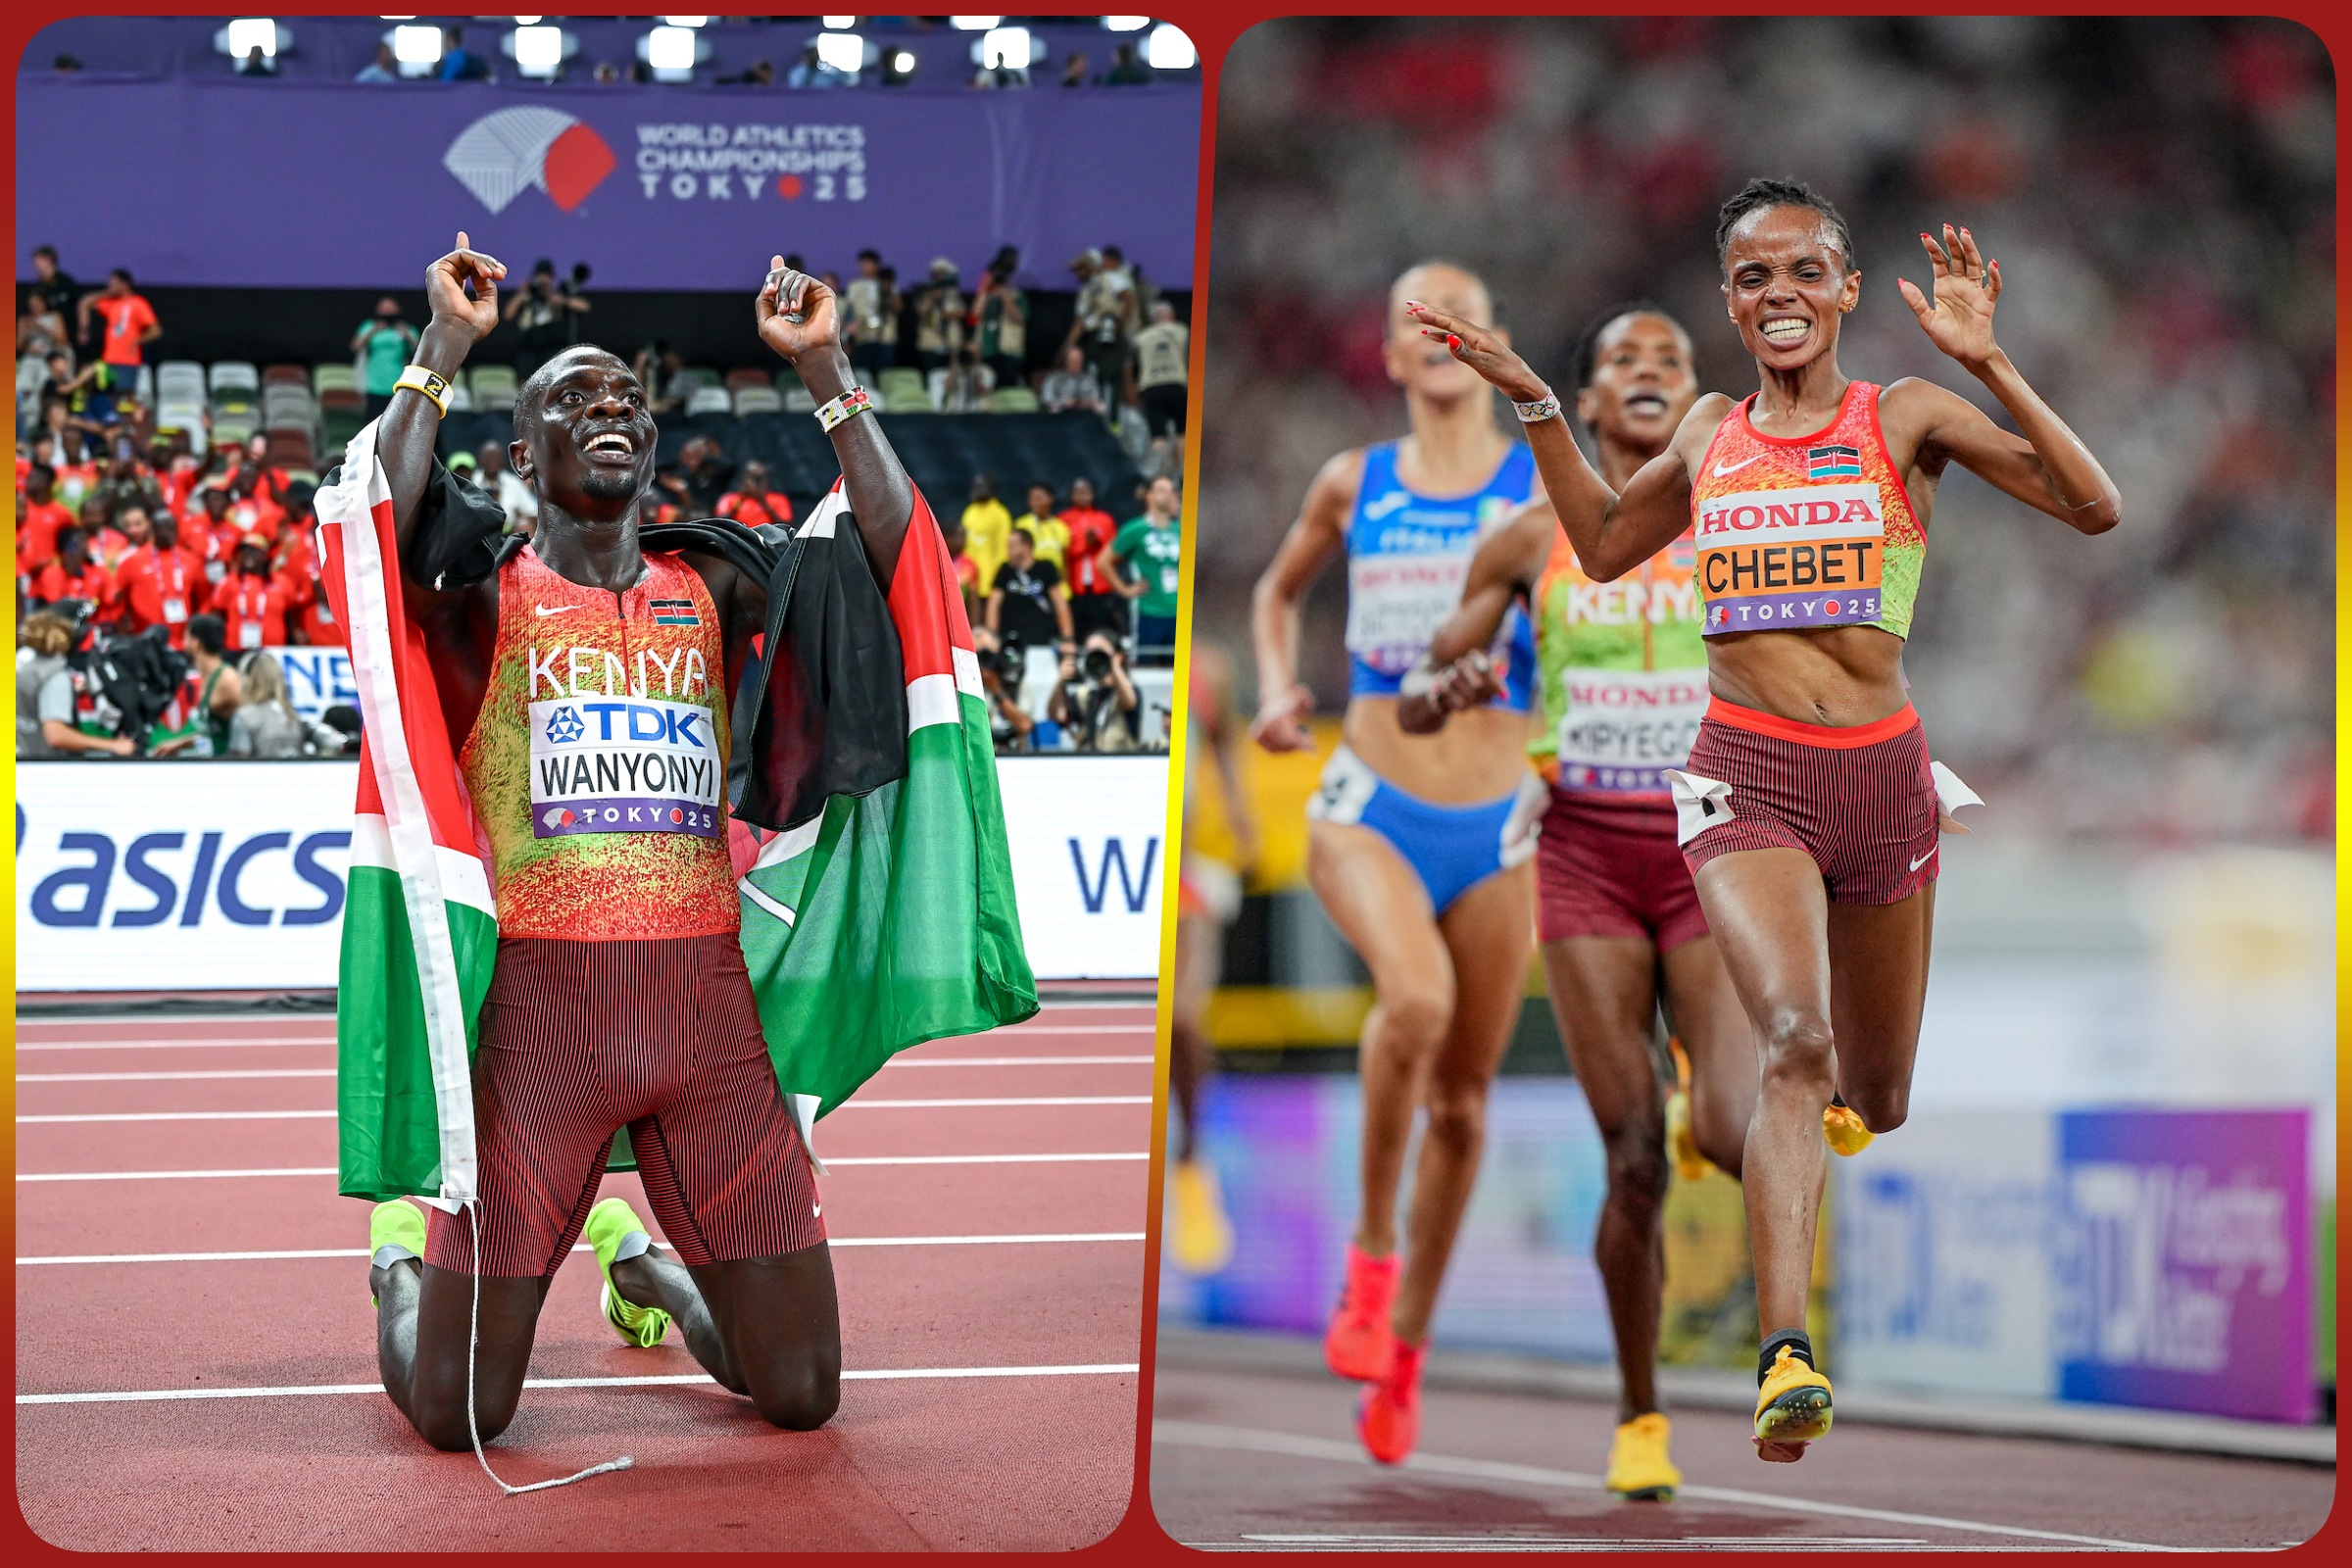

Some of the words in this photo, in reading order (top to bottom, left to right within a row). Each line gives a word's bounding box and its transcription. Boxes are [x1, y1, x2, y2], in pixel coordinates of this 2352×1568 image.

[637, 125, 729, 146] WORLD
[732, 125, 864, 146] ATHLETICS
[637, 149, 865, 172] CHAMPIONSHIPS
[814, 174, 865, 200] 25
[1699, 499, 1880, 536] HONDA
[1705, 542, 1873, 593] CHEBET
[1567, 580, 1699, 625] KENY
[1847, 598, 1876, 616] 25
[528, 646, 710, 700] KENYA
[1570, 681, 1709, 710] HOND
[583, 703, 706, 748] TDK
[540, 752, 713, 797] WANYONYI
[687, 810, 712, 830] 25
[1068, 838, 1159, 914] W
